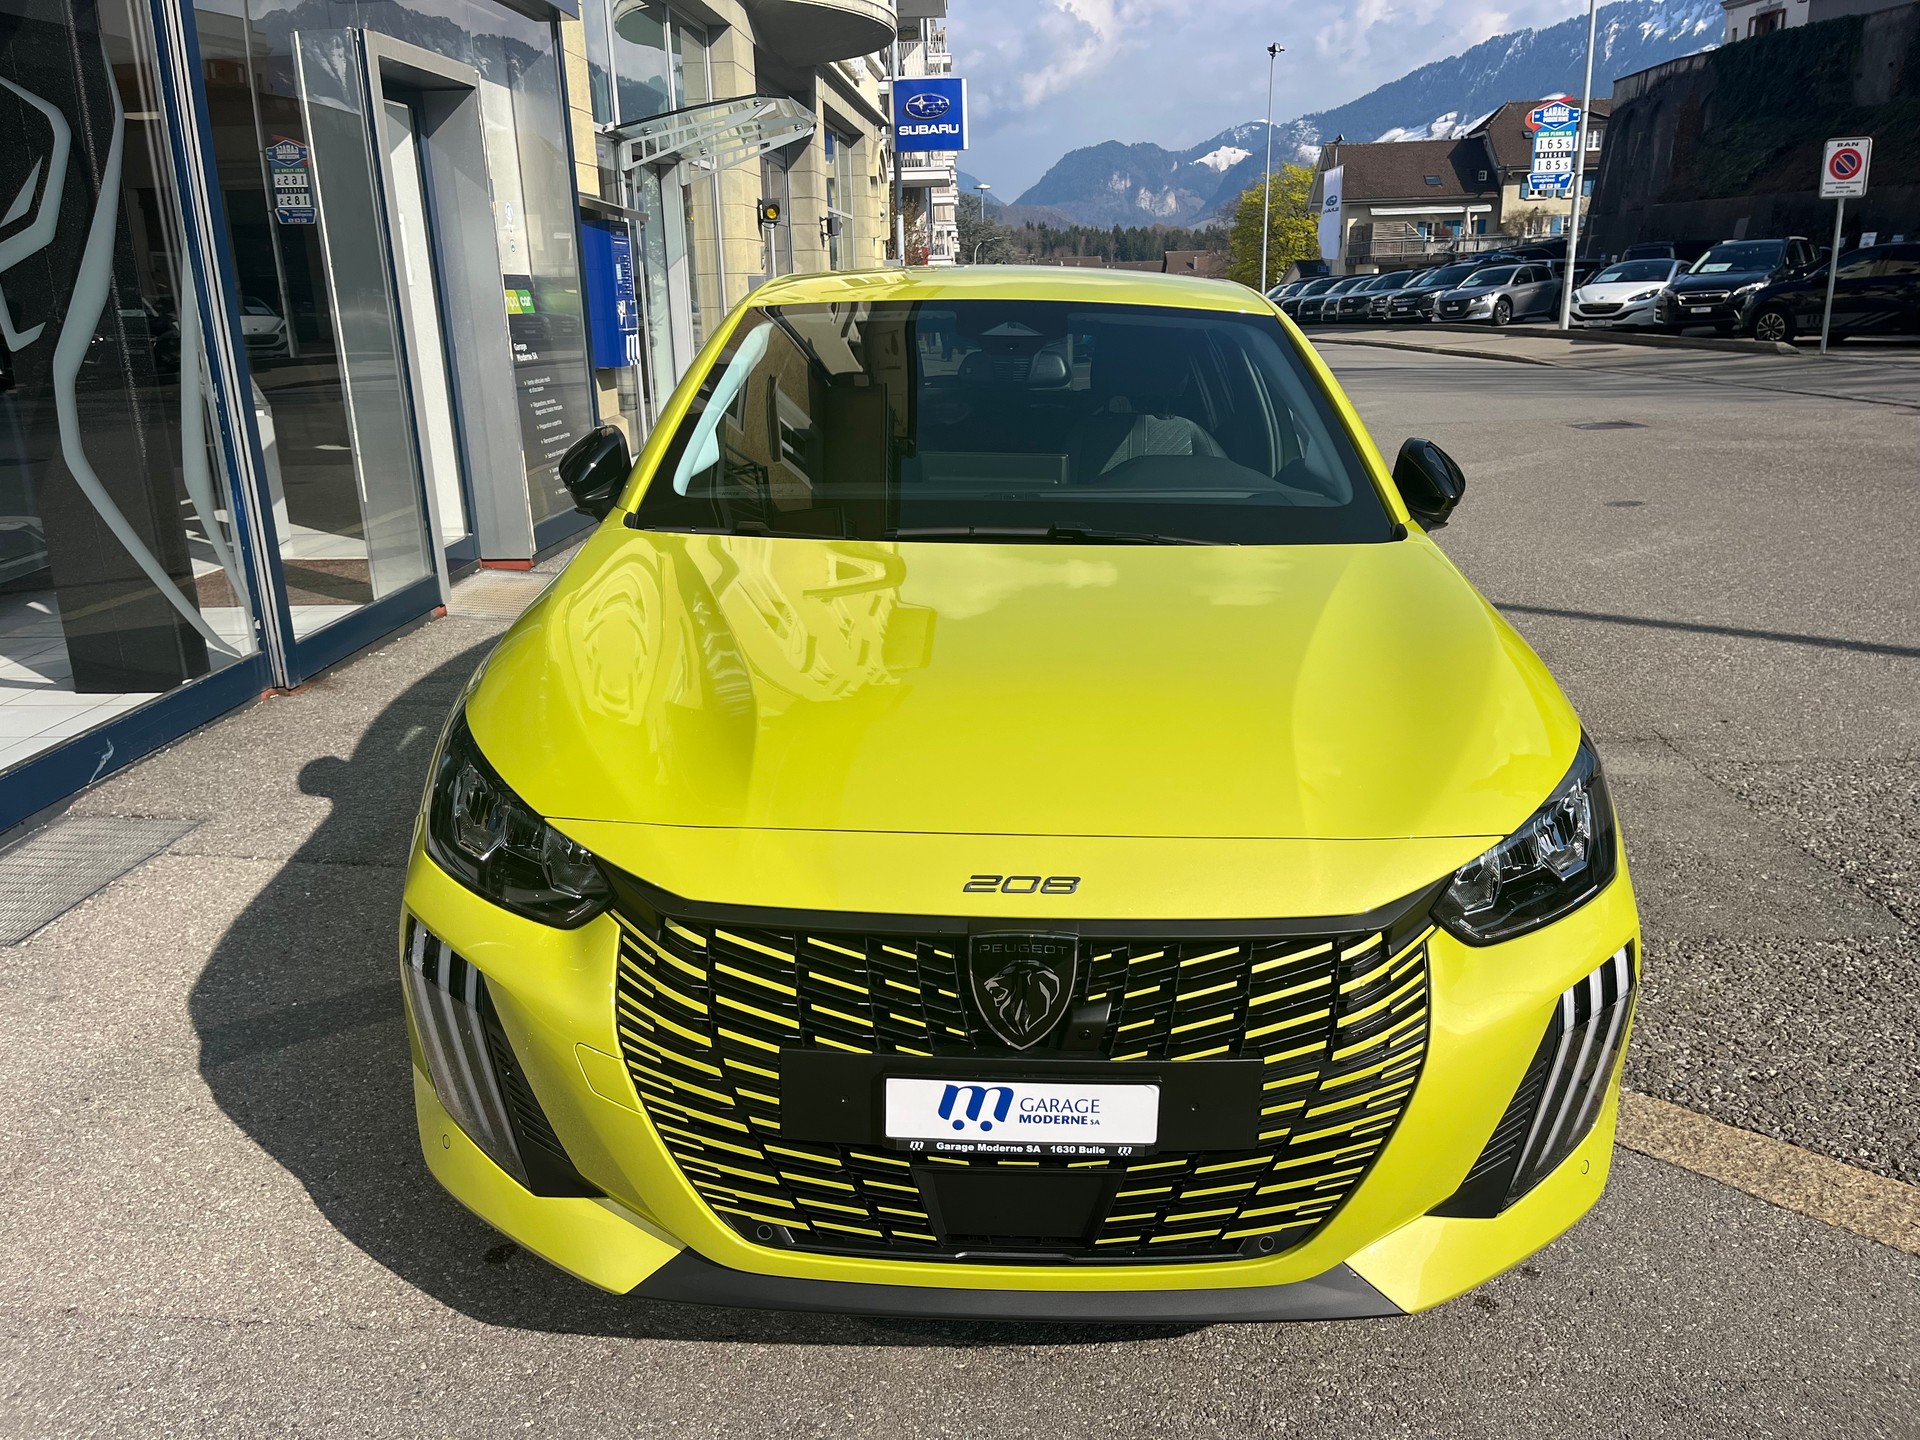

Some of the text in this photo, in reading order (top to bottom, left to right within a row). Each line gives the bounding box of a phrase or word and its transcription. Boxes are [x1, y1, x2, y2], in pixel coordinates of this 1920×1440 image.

[898, 124, 959, 136] SUBARU
[963, 875, 1081, 894] 208
[980, 944, 1068, 954] PEUGEOT
[1020, 1098, 1100, 1113] GARAGE
[1019, 1114, 1088, 1125] MODERNE
[936, 1142, 974, 1152] Garage
[977, 1144, 1023, 1152] Moderne
